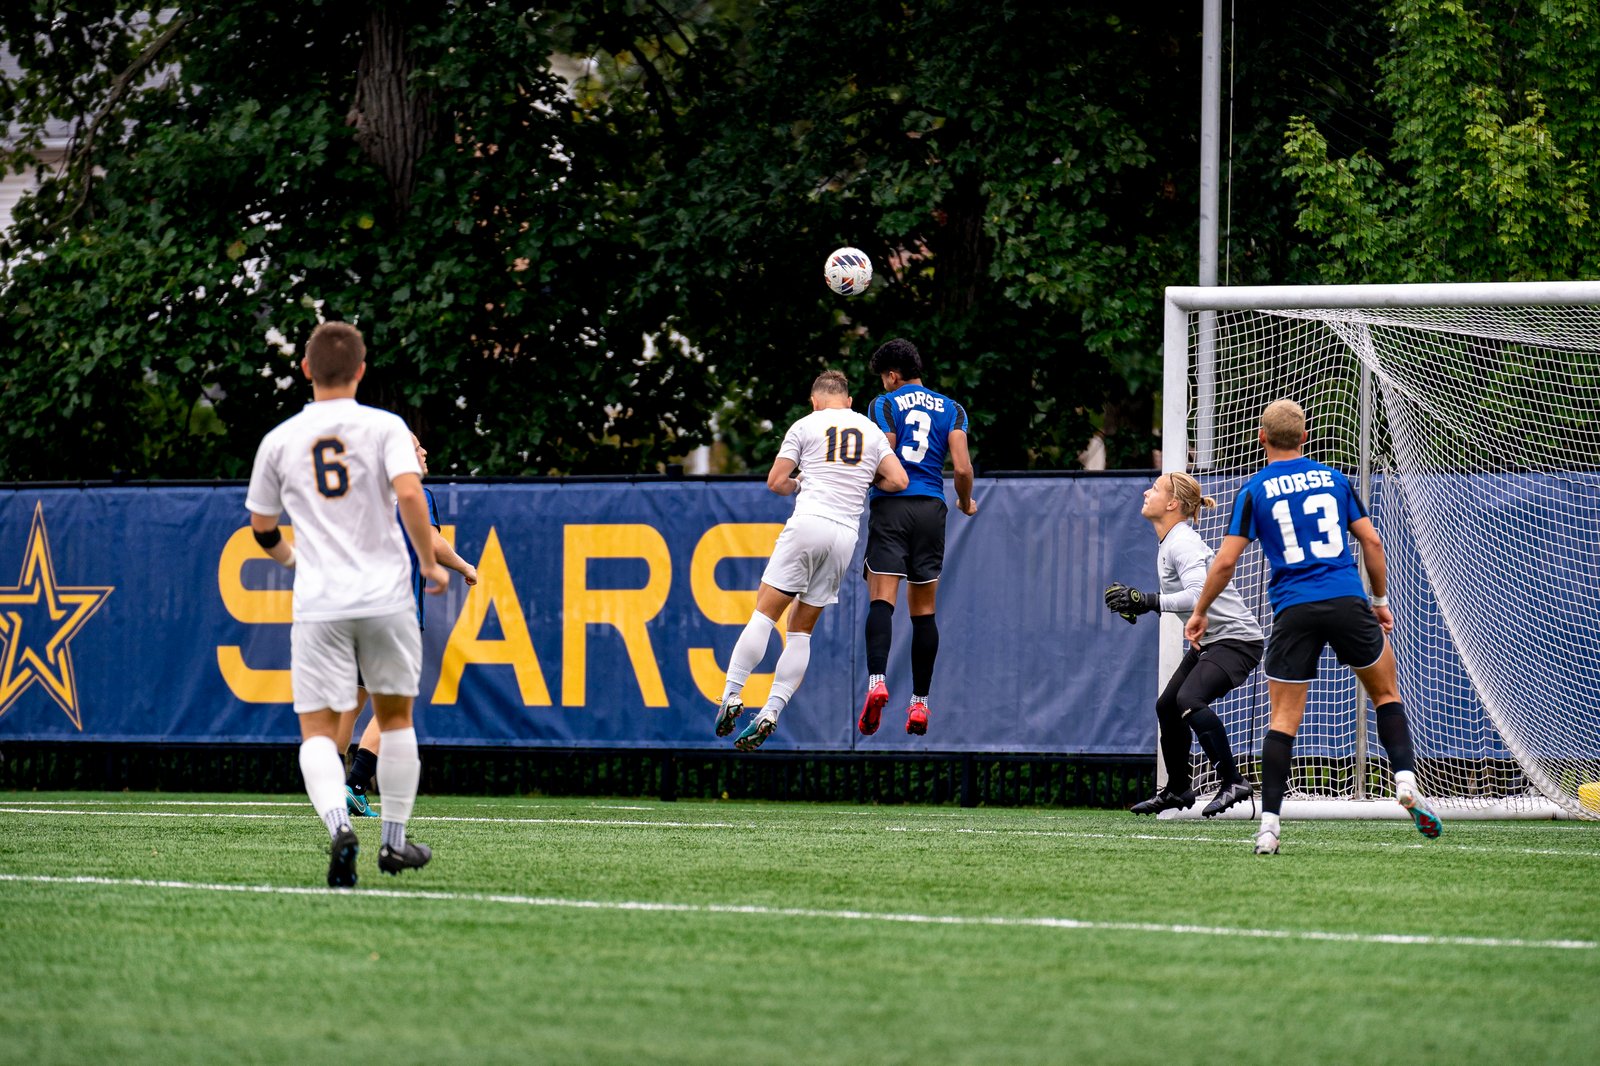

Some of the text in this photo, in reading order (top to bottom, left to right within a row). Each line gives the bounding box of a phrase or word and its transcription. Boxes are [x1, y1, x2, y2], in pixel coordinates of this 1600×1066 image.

[894, 391, 945, 413] NORSE
[825, 426, 864, 466] 10
[901, 409, 932, 463] 3
[311, 435, 350, 500] 6
[1263, 470, 1335, 499] NORSE
[1271, 493, 1344, 565] 13
[217, 523, 791, 708] SARS
